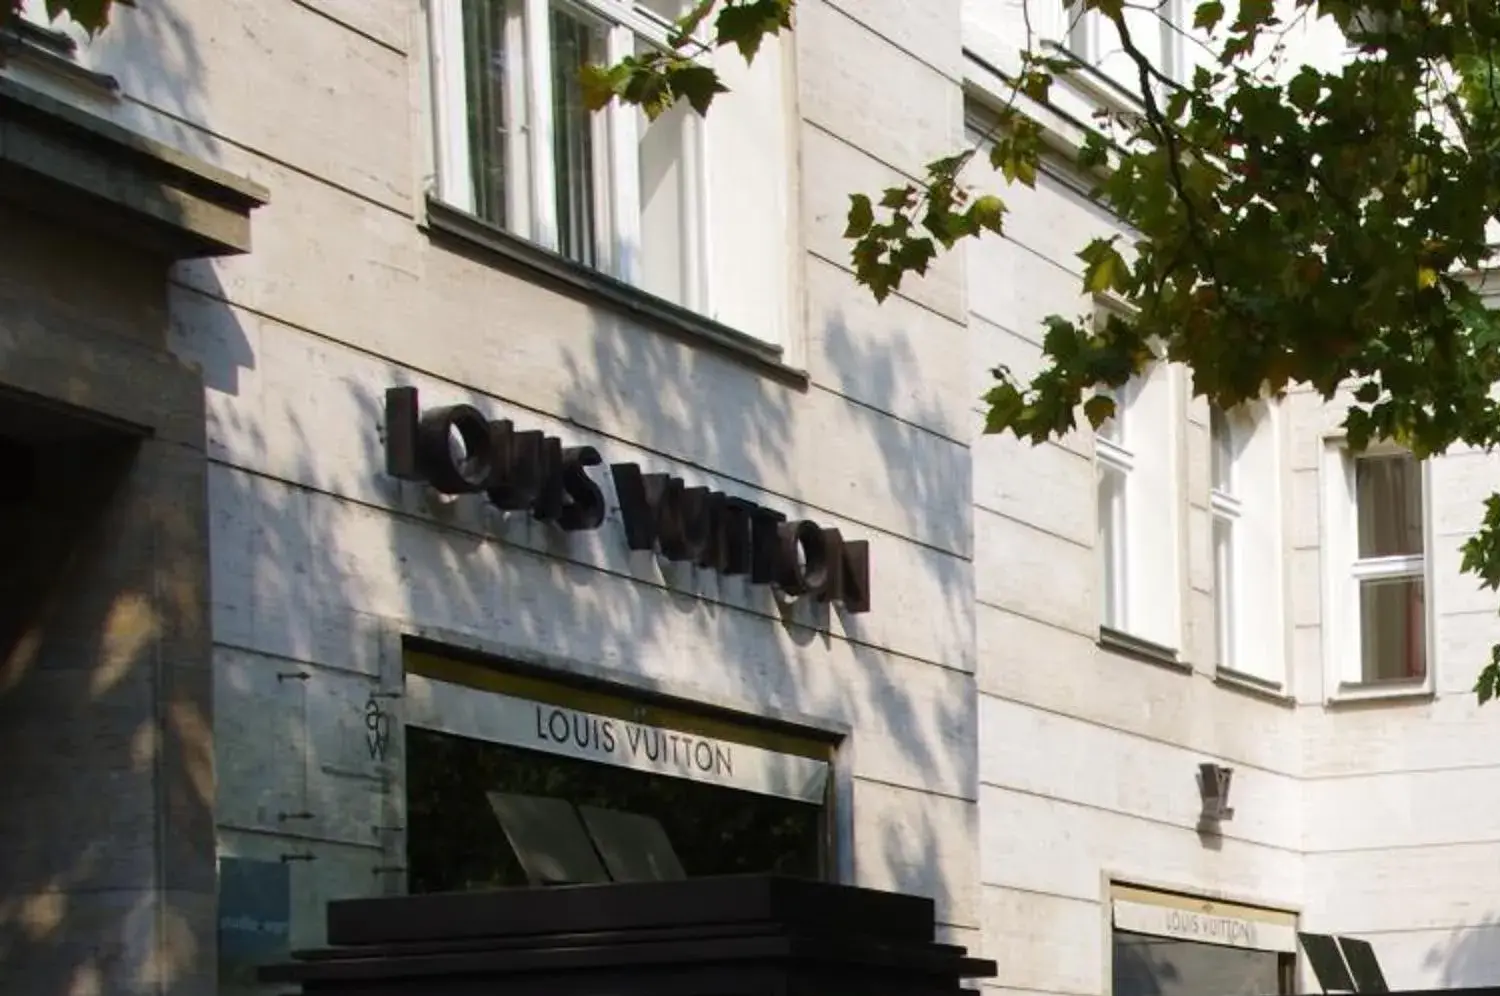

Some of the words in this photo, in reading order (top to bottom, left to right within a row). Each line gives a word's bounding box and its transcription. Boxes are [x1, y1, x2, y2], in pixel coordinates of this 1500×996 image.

[536, 704, 614, 753] LOUIS
[625, 725, 733, 778] VUITTON
[1165, 910, 1199, 934] LOUIS
